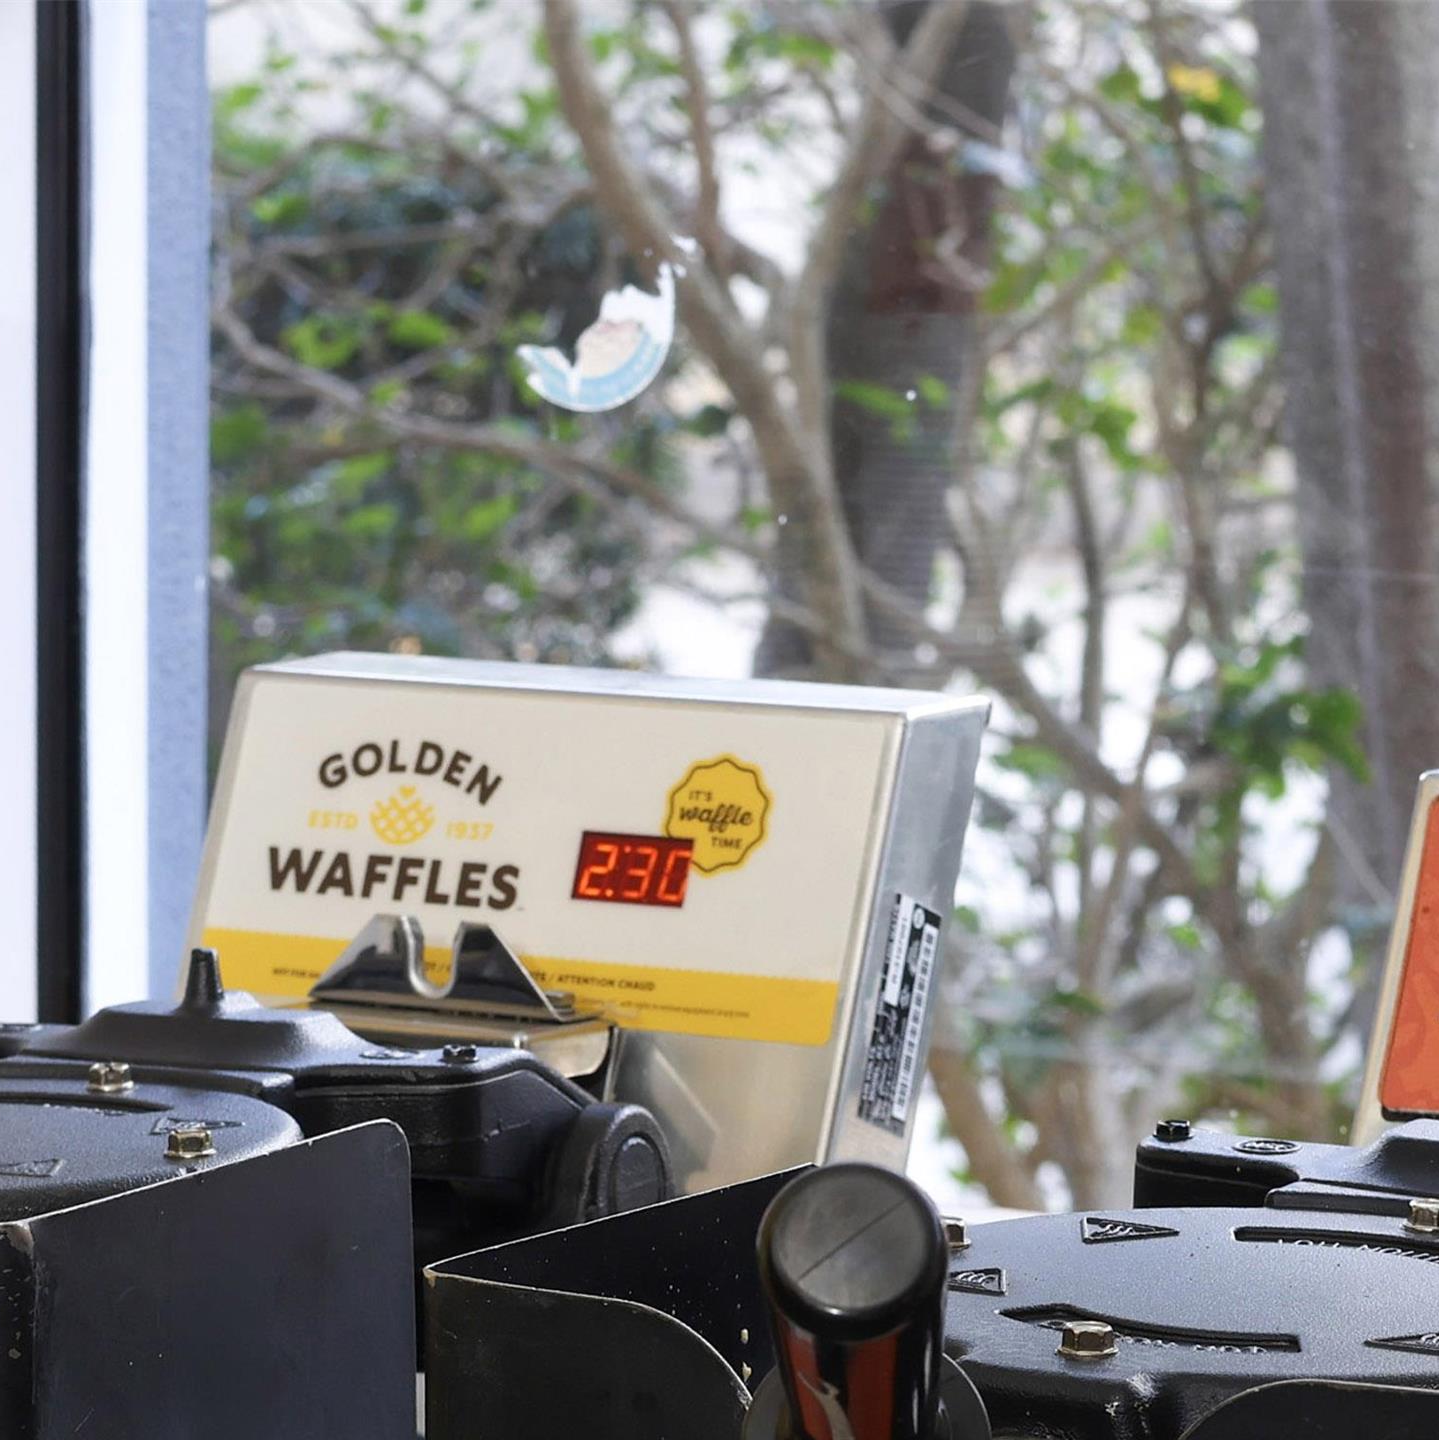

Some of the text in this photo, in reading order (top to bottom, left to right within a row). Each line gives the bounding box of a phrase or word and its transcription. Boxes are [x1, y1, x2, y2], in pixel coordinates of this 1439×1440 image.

[318, 739, 502, 806] GOLDEN
[688, 790, 713, 801] IT'S
[307, 809, 358, 830] ESTD
[679, 803, 754, 833] waffle
[711, 837, 743, 849] TIME
[268, 845, 520, 910] WAFFLES
[618, 979, 655, 991] CHAUD
